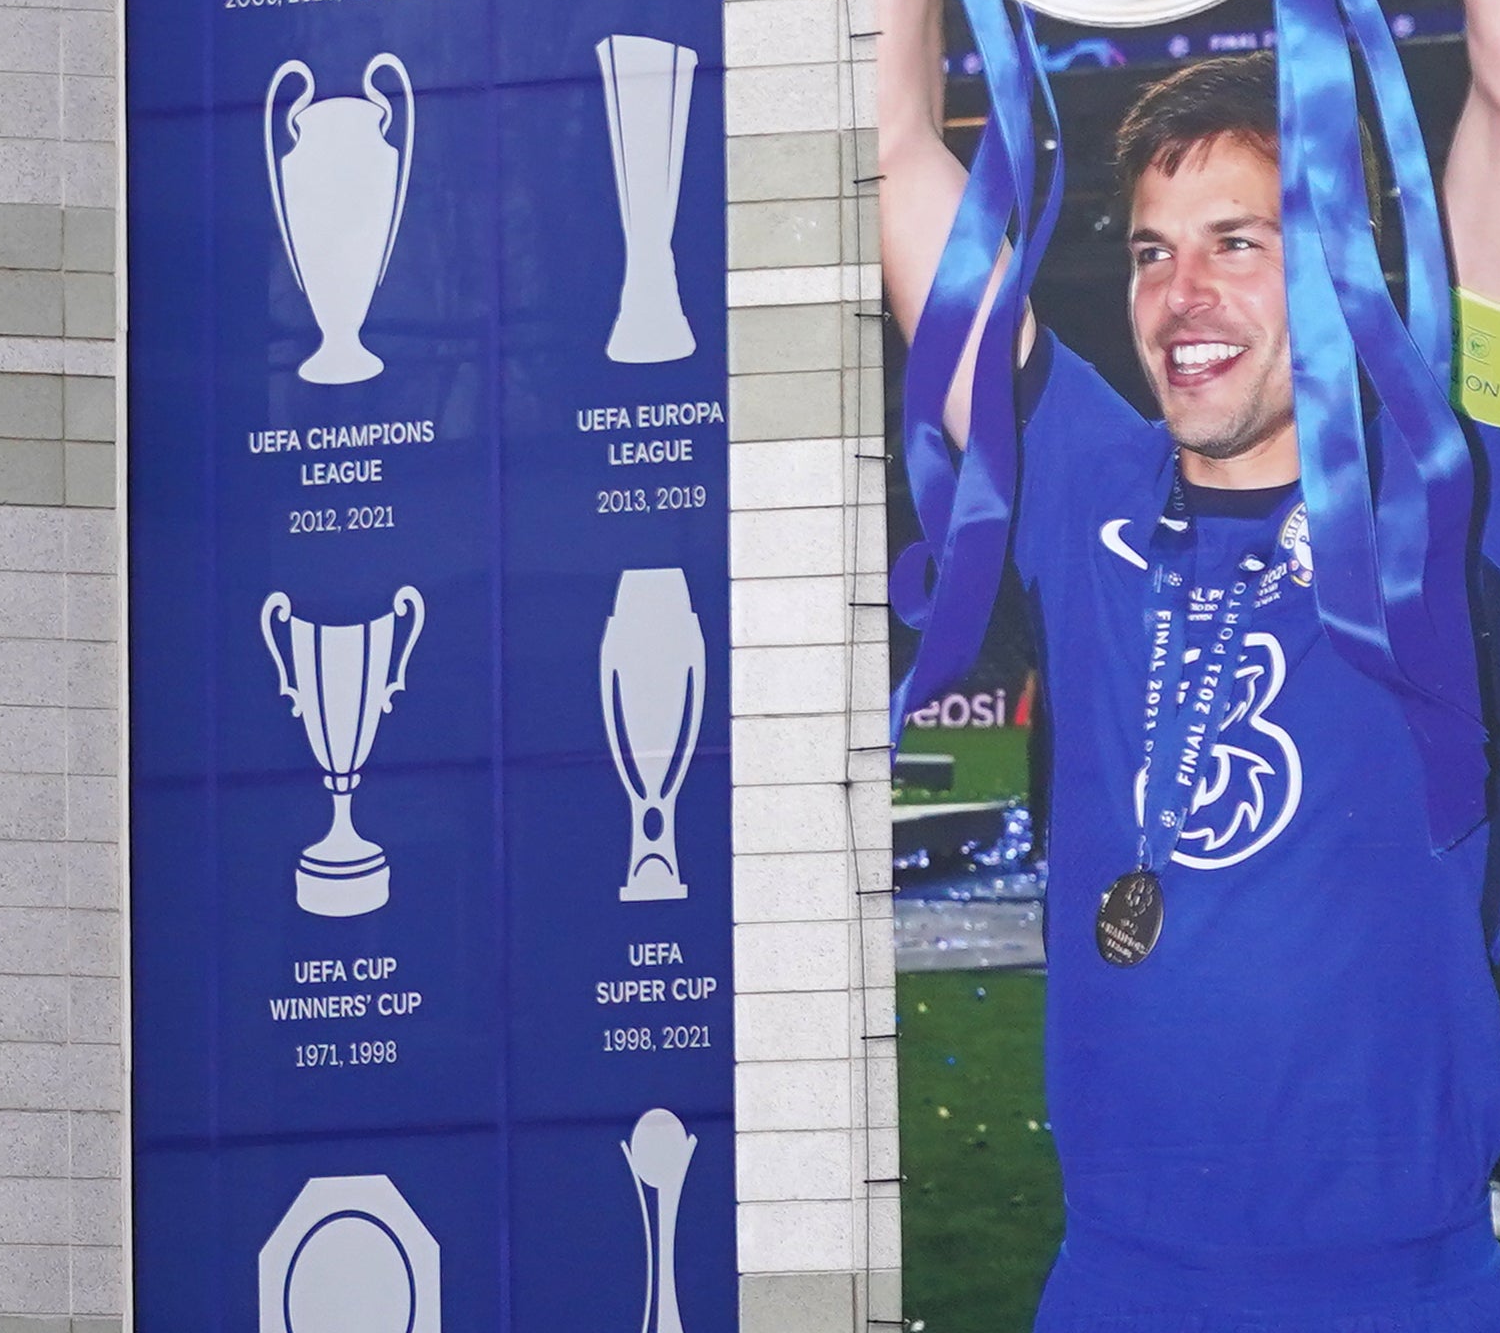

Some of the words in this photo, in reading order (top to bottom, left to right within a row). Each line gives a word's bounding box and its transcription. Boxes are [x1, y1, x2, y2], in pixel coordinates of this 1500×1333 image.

[578, 408, 631, 431] UEFA
[637, 402, 724, 427] EUROPA
[249, 430, 301, 453] UEFA
[307, 420, 434, 449] CHAMPIONS
[609, 439, 692, 465] LEAGUE
[302, 460, 382, 485] LEAGUE
[598, 489, 650, 513] 2013,
[657, 486, 706, 509] 2019
[290, 509, 341, 533] 2012,
[348, 506, 394, 529] 2021
[1149, 609, 1172, 672] FINAL
[1176, 722, 1207, 787] FINAL
[1193, 663, 1223, 715] 2021
[1211, 581, 1247, 655] PORTO
[629, 943, 683, 966] UEFA
[295, 960, 347, 983] UEFA
[353, 957, 396, 981] CUP
[597, 980, 665, 1004] SUPER
[671, 977, 716, 1000] CUP
[270, 995, 371, 1020] WINNERS’
[377, 992, 421, 1015] CUP
[604, 1028, 656, 1051] 1998,
[663, 1026, 711, 1048] 2021
[296, 1044, 343, 1067] 1971,
[350, 1041, 396, 1064] 1998
